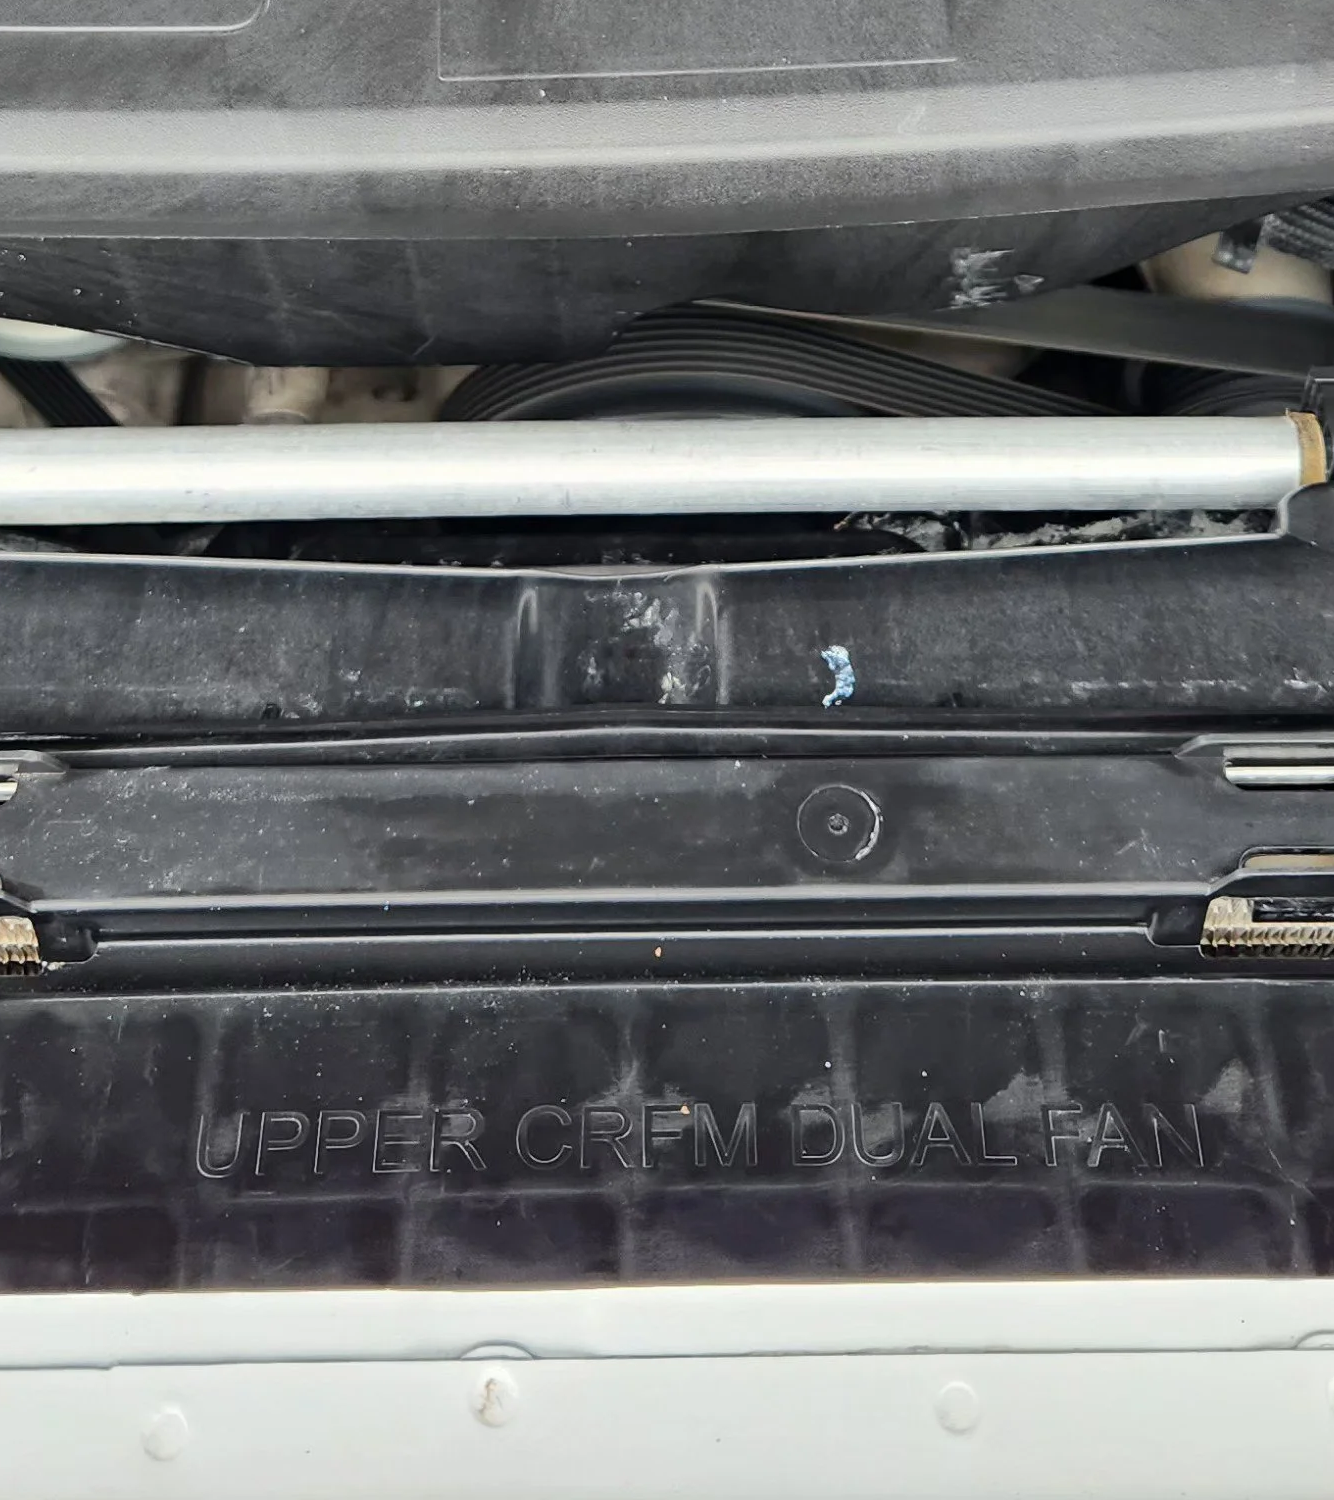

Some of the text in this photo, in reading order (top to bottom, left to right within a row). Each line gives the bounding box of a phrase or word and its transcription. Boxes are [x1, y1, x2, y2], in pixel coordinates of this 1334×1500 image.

[196, 1102, 1205, 1179] UPPER CRFM DUAL FAN
